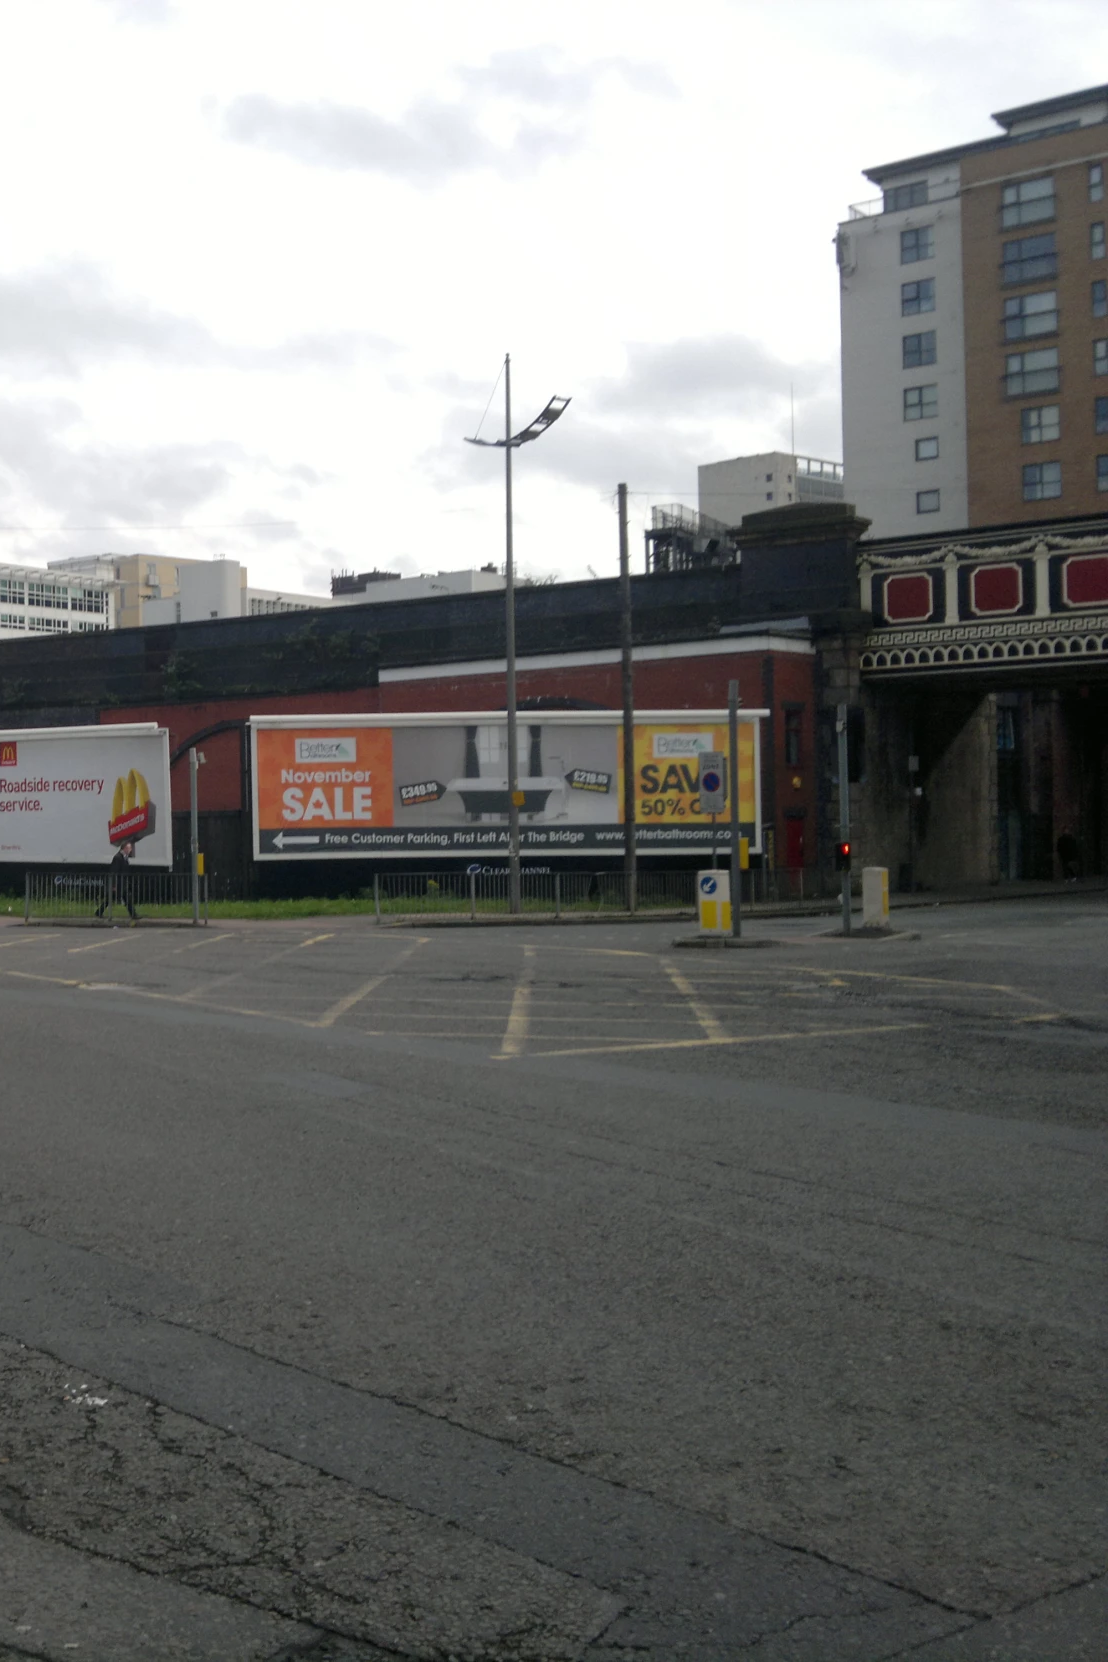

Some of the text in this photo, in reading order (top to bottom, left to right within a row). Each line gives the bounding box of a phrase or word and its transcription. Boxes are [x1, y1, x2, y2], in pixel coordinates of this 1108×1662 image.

[280, 768, 372, 784] November
[640, 763, 701, 794] SAV
[0, 777, 105, 795] Roadside recovery
[0, 797, 43, 812] service.
[281, 786, 373, 822] SALE
[641, 799, 686, 816] 50%
[324, 833, 349, 844] Free
[351, 832, 405, 844] Customer
[407, 832, 451, 846] Parking,
[453, 832, 475, 843] First
[476, 831, 497, 843] Left
[527, 831, 548, 842] The
[549, 830, 585, 845] Bridge
